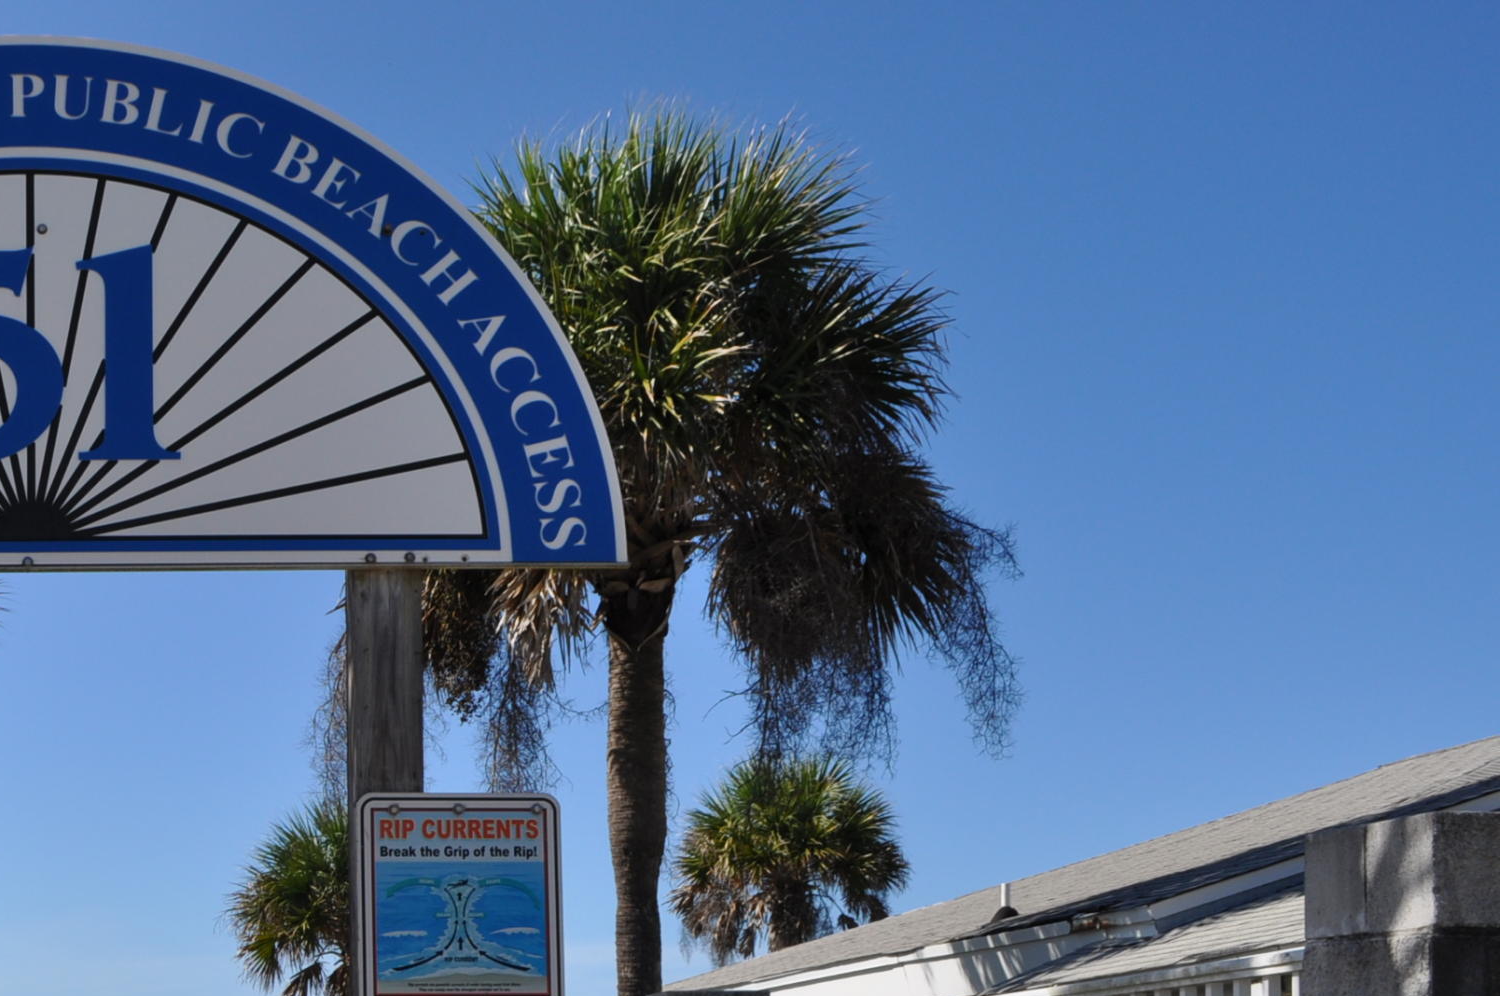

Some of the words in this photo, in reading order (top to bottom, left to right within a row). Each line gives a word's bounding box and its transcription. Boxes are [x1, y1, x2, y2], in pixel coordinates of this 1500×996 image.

[10, 74, 266, 160] PUBLIC
[272, 134, 480, 306] BEACH
[457, 314, 587, 550] ACCESS
[379, 819, 415, 840] RIP
[421, 819, 539, 840] CURRENTS
[380, 846, 416, 857] Break
[420, 846, 440, 857] the
[444, 845, 470, 860] Grip
[473, 846, 486, 857] of
[489, 846, 510, 857] the
[513, 846, 537, 860] Rip!
